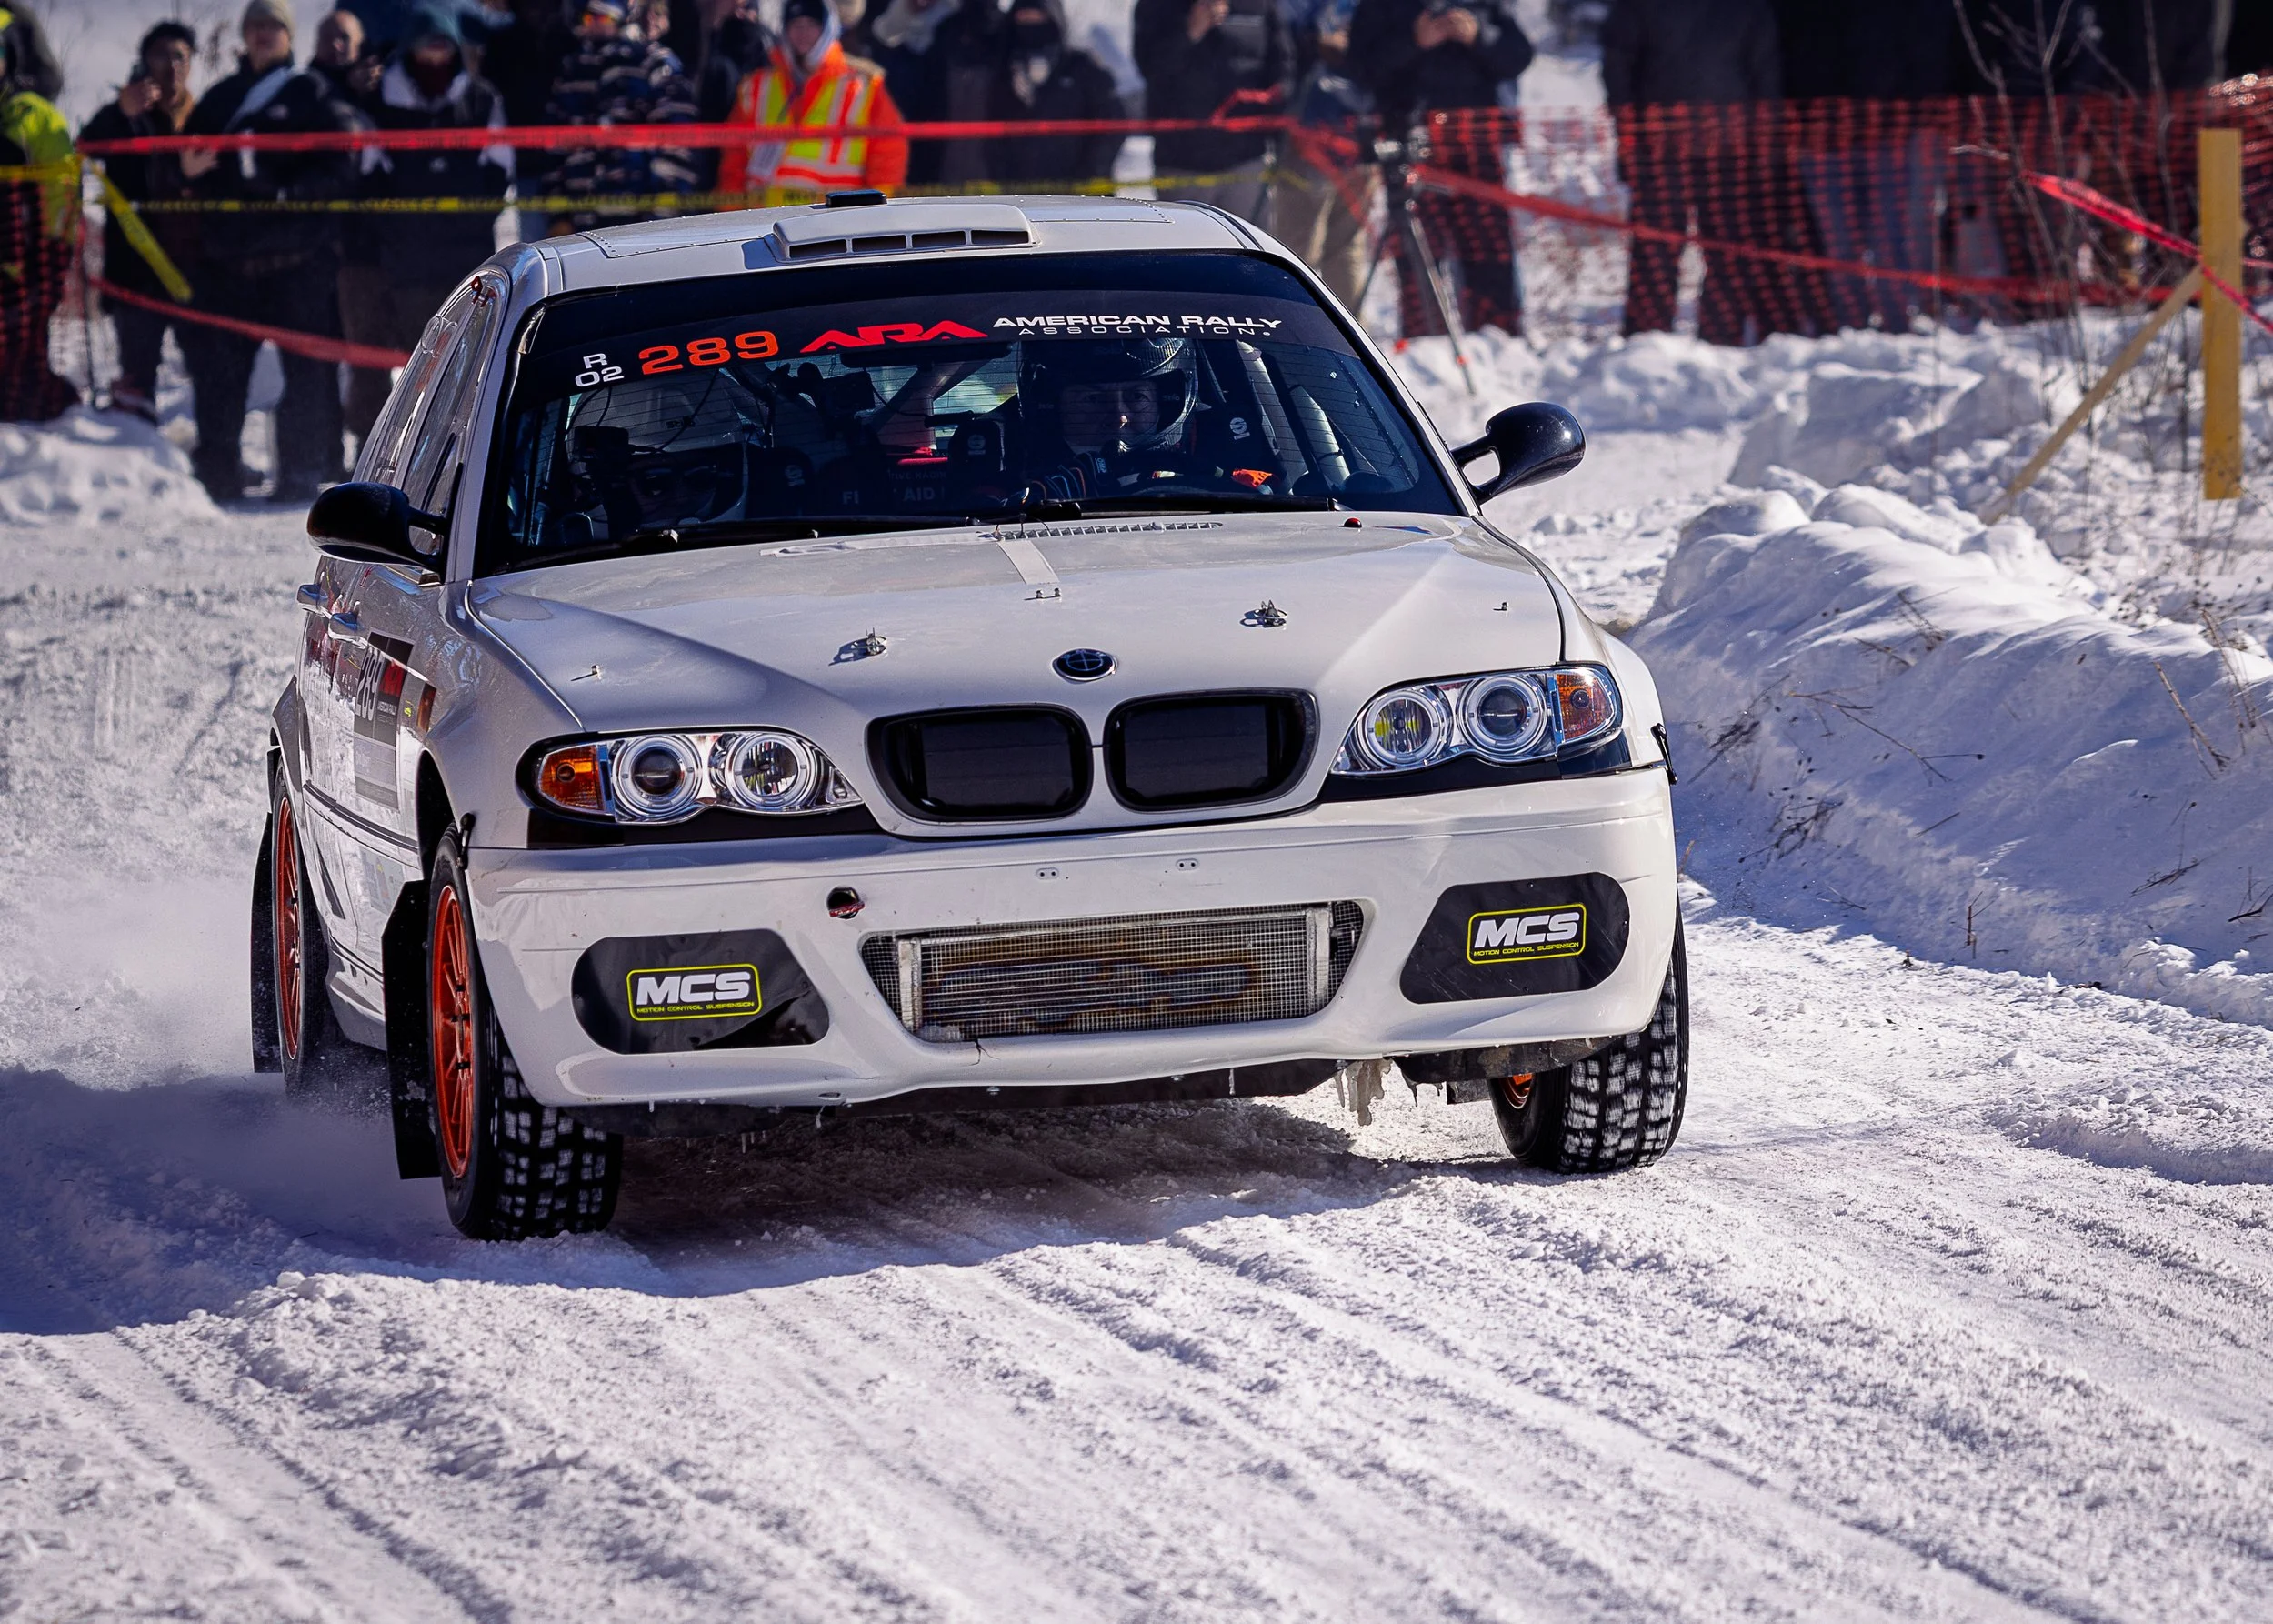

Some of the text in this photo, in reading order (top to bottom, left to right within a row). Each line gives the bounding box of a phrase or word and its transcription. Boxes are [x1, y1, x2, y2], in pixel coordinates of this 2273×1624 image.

[993, 315, 1282, 328] AMERICAN RALLY
[799, 320, 988, 354] ARA
[583, 353, 608, 369] R
[638, 330, 780, 375] 289
[902, 486, 936, 502] AID
[355, 646, 383, 720] 289
[1474, 912, 1580, 948] MCS
[1502, 947, 1535, 955] CONTROL
[1537, 942, 1579, 950] SUSPENSION
[636, 972, 752, 1006] MCS
[706, 1001, 755, 1009] SUSPENSION
